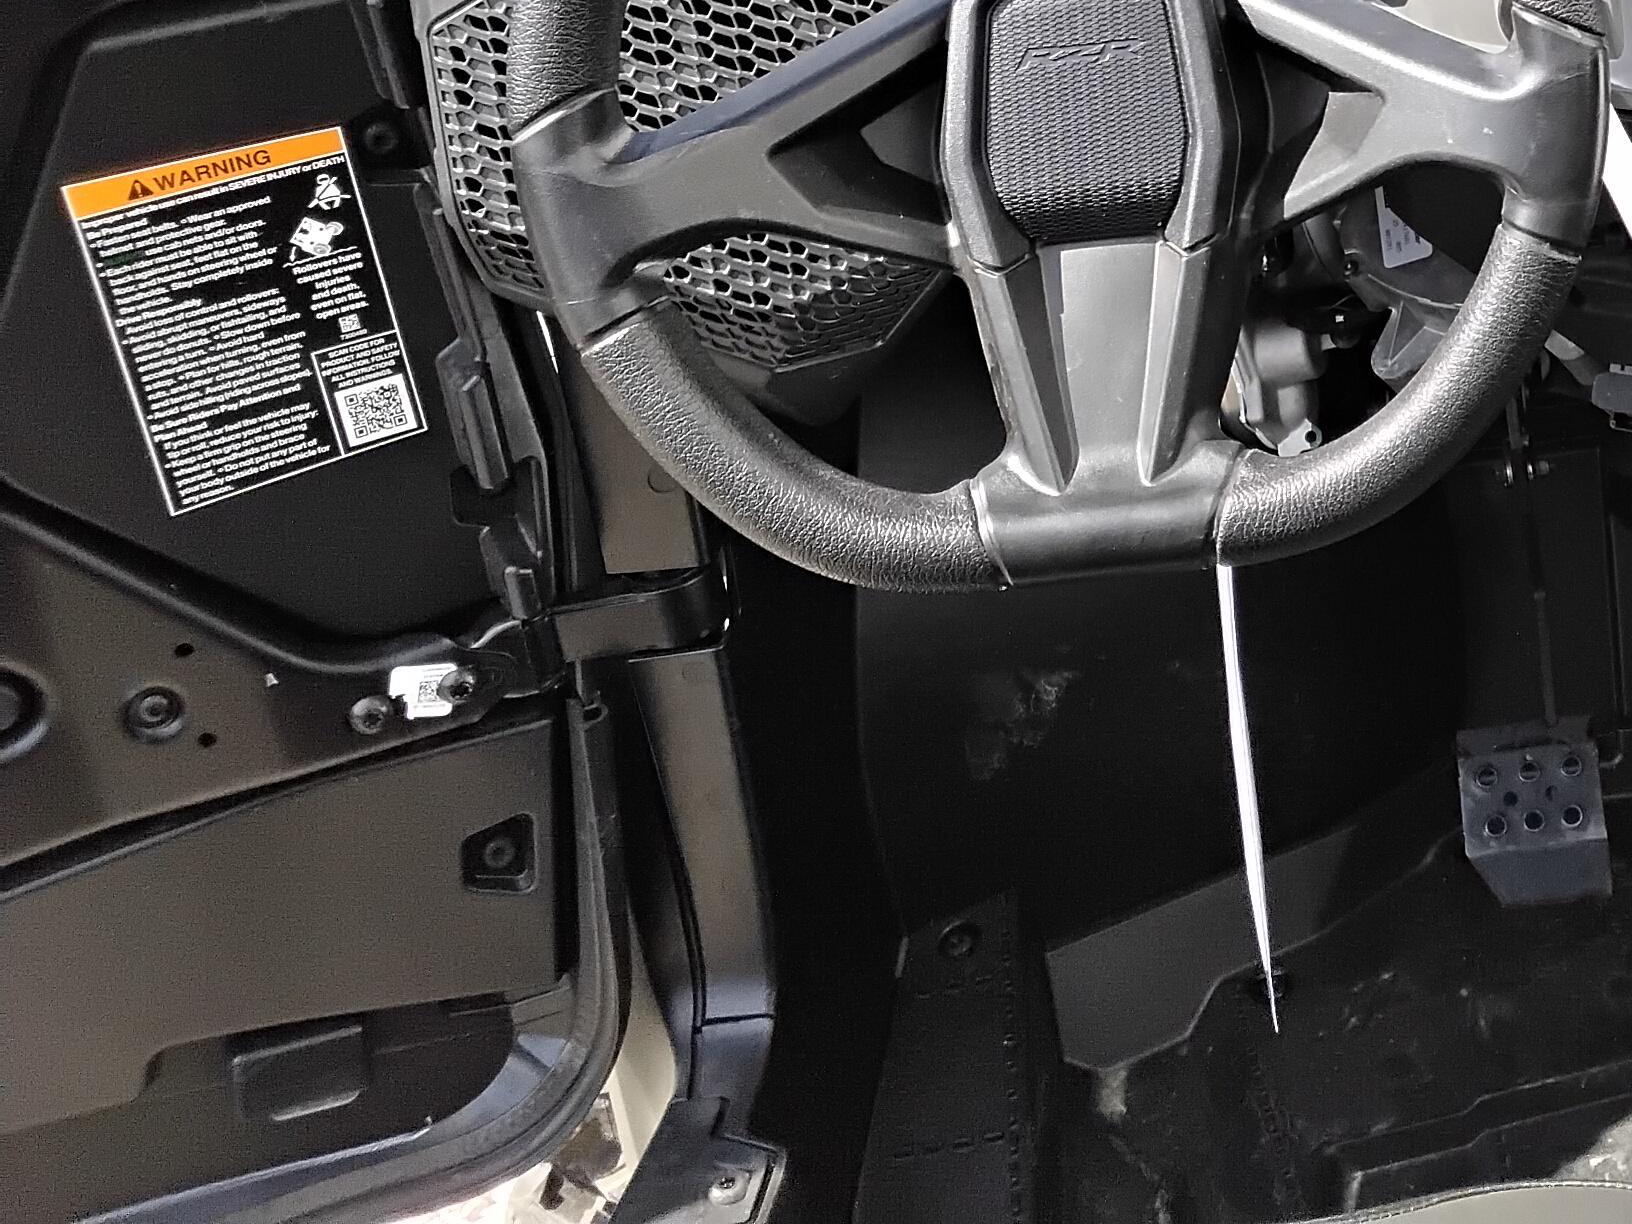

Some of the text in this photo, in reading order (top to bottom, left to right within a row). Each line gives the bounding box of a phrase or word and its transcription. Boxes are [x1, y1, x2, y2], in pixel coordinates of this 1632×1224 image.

[153, 150, 272, 192] WARNING
[228, 175, 265, 190] SEVERE
[266, 166, 300, 180] INJURY
[312, 155, 344, 169] DEATH
[292, 252, 361, 274] Rollovers have
[311, 283, 359, 300] and death,
[310, 299, 333, 310] even
[316, 308, 340, 318] open
[369, 338, 384, 346] FOR
